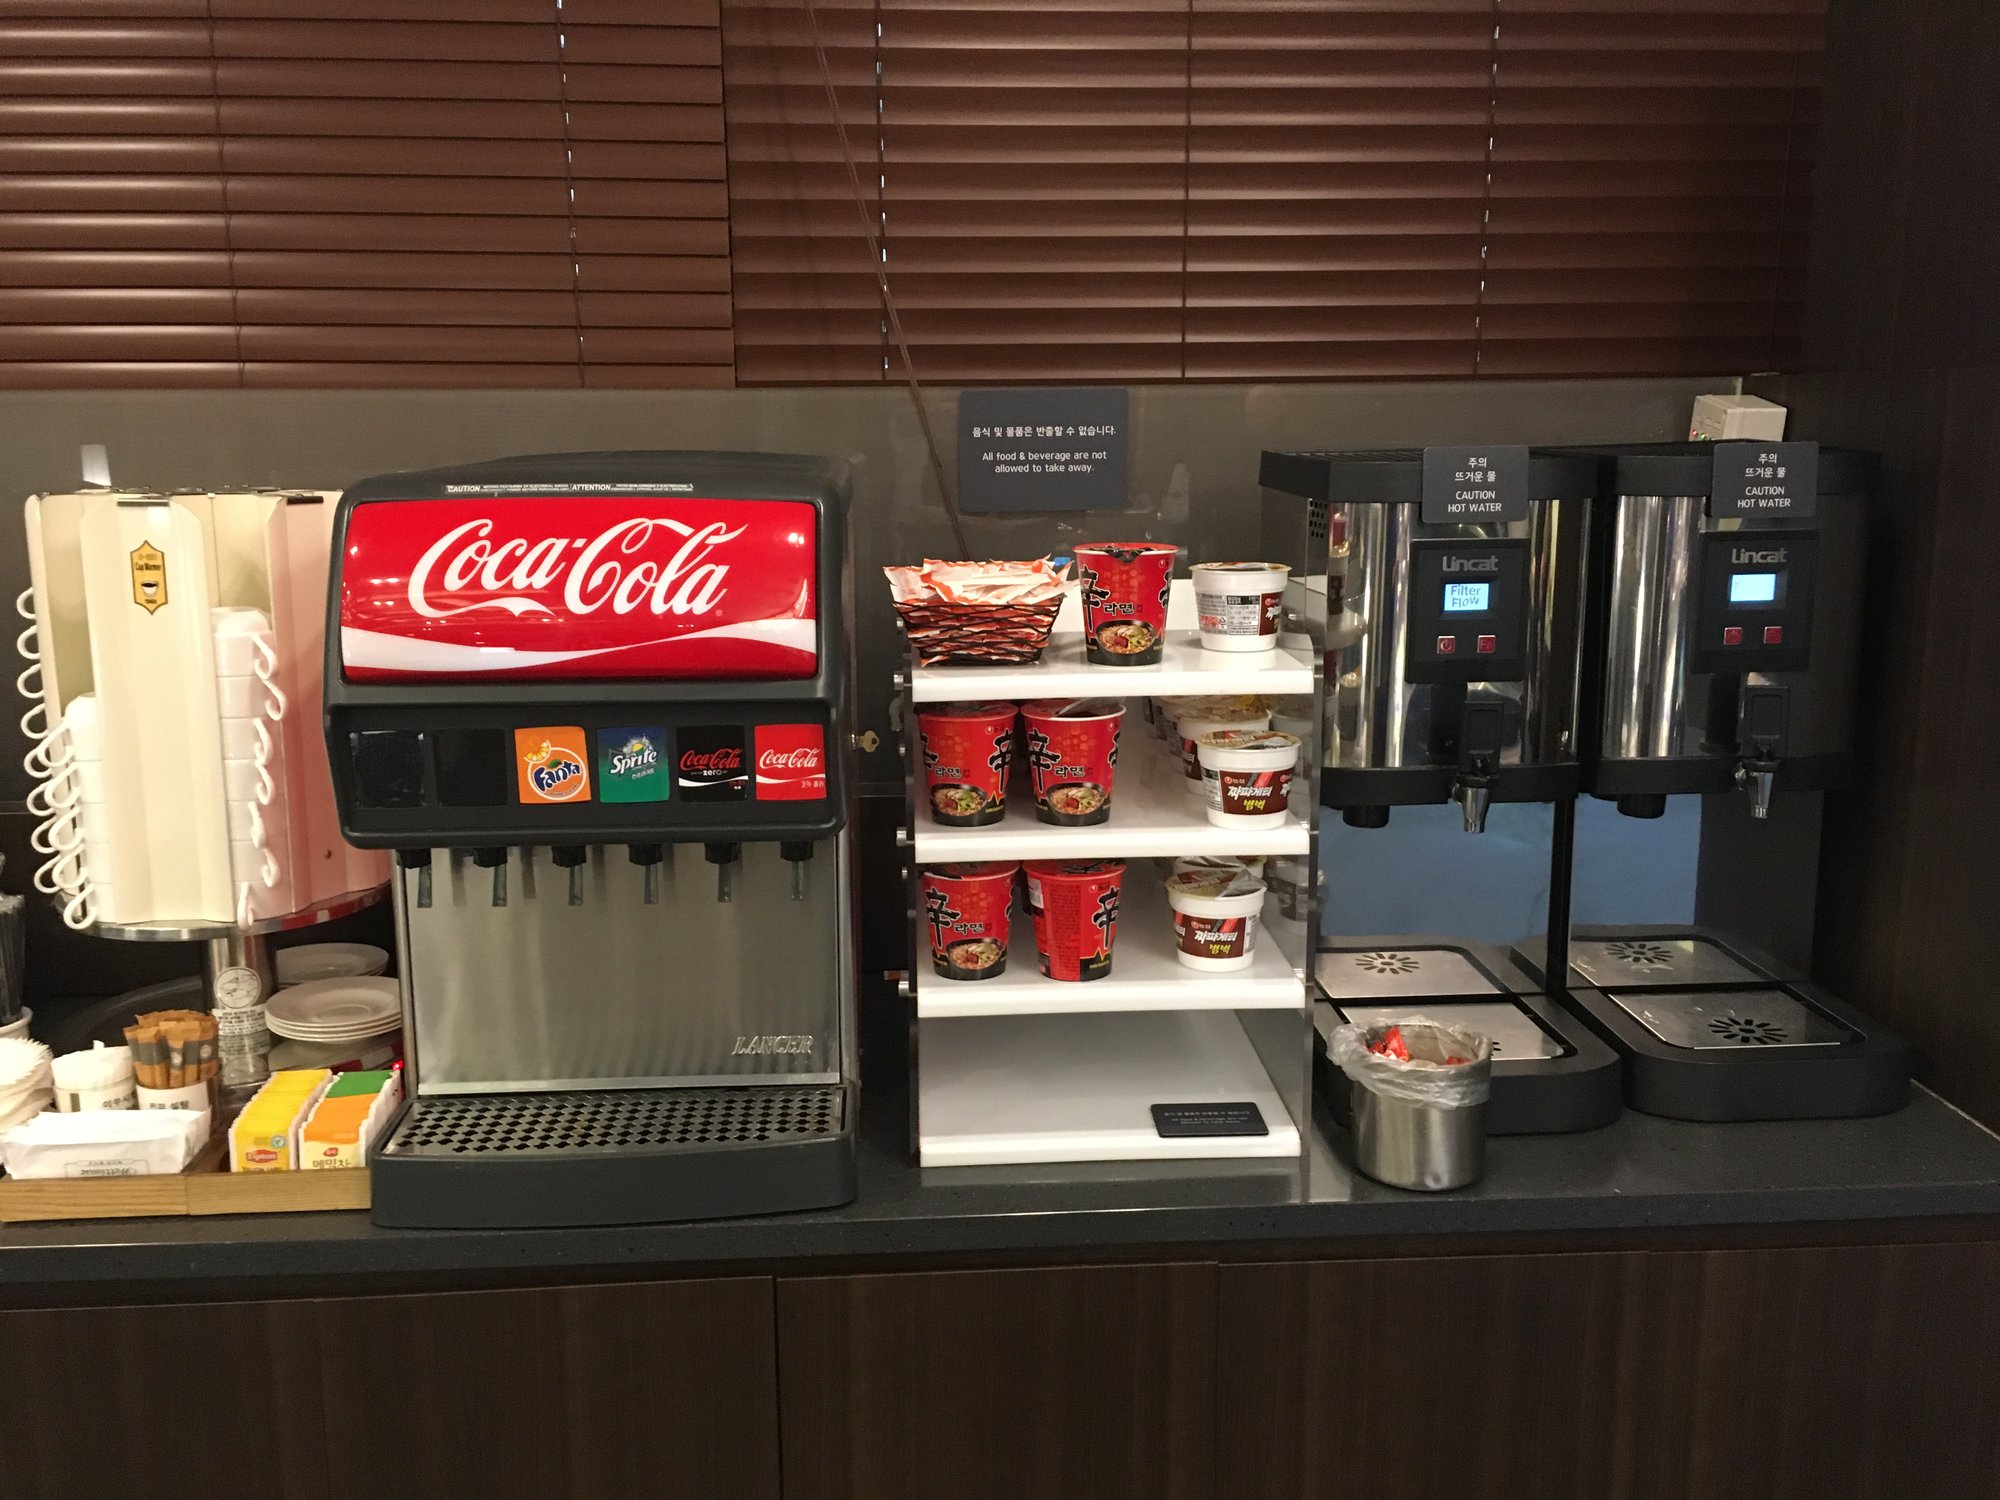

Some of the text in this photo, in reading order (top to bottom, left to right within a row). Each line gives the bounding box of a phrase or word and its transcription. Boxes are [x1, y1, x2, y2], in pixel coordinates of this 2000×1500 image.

[972, 425, 1117, 438] 음식 및 물품은 반출할 수 없습니다.
[982, 450, 1107, 462] All food & beverage are not
[1758, 453, 1778, 465] 주의
[994, 463, 1095, 474] allowed to take away.
[1467, 457, 1488, 469] 주의
[1454, 470, 1497, 482] 뜨거운 물
[1744, 466, 1787, 478] 뜨거운 물
[447, 485, 481, 493] CAUTION
[1455, 490, 1496, 500] CAUTION
[1745, 486, 1785, 496] CAUTION
[1447, 502, 1502, 513] HOT WATER
[1737, 498, 1791, 508] HOT WATER
[1731, 547, 1788, 564] Lincat
[407, 517, 749, 618] Coca-Cola
[1442, 554, 1499, 572] Lincat
[1450, 584, 1481, 596] Filter
[1103, 602, 1134, 616] 라면
[610, 750, 658, 775] Sprite
[680, 748, 743, 771] Coca-Cola
[759, 748, 821, 770] Coca-Cola
[533, 760, 581, 792] Fanta
[935, 766, 961, 778] 라면
[1054, 765, 1085, 778] 라면
[1228, 785, 1273, 800] 짜파게티
[1243, 799, 1266, 811] 범벅
[954, 922, 984, 935] 라면
[1194, 930, 1238, 944] 짜파게티
[1209, 943, 1232, 954] 범벅
[731, 1035, 814, 1055] LANCER
